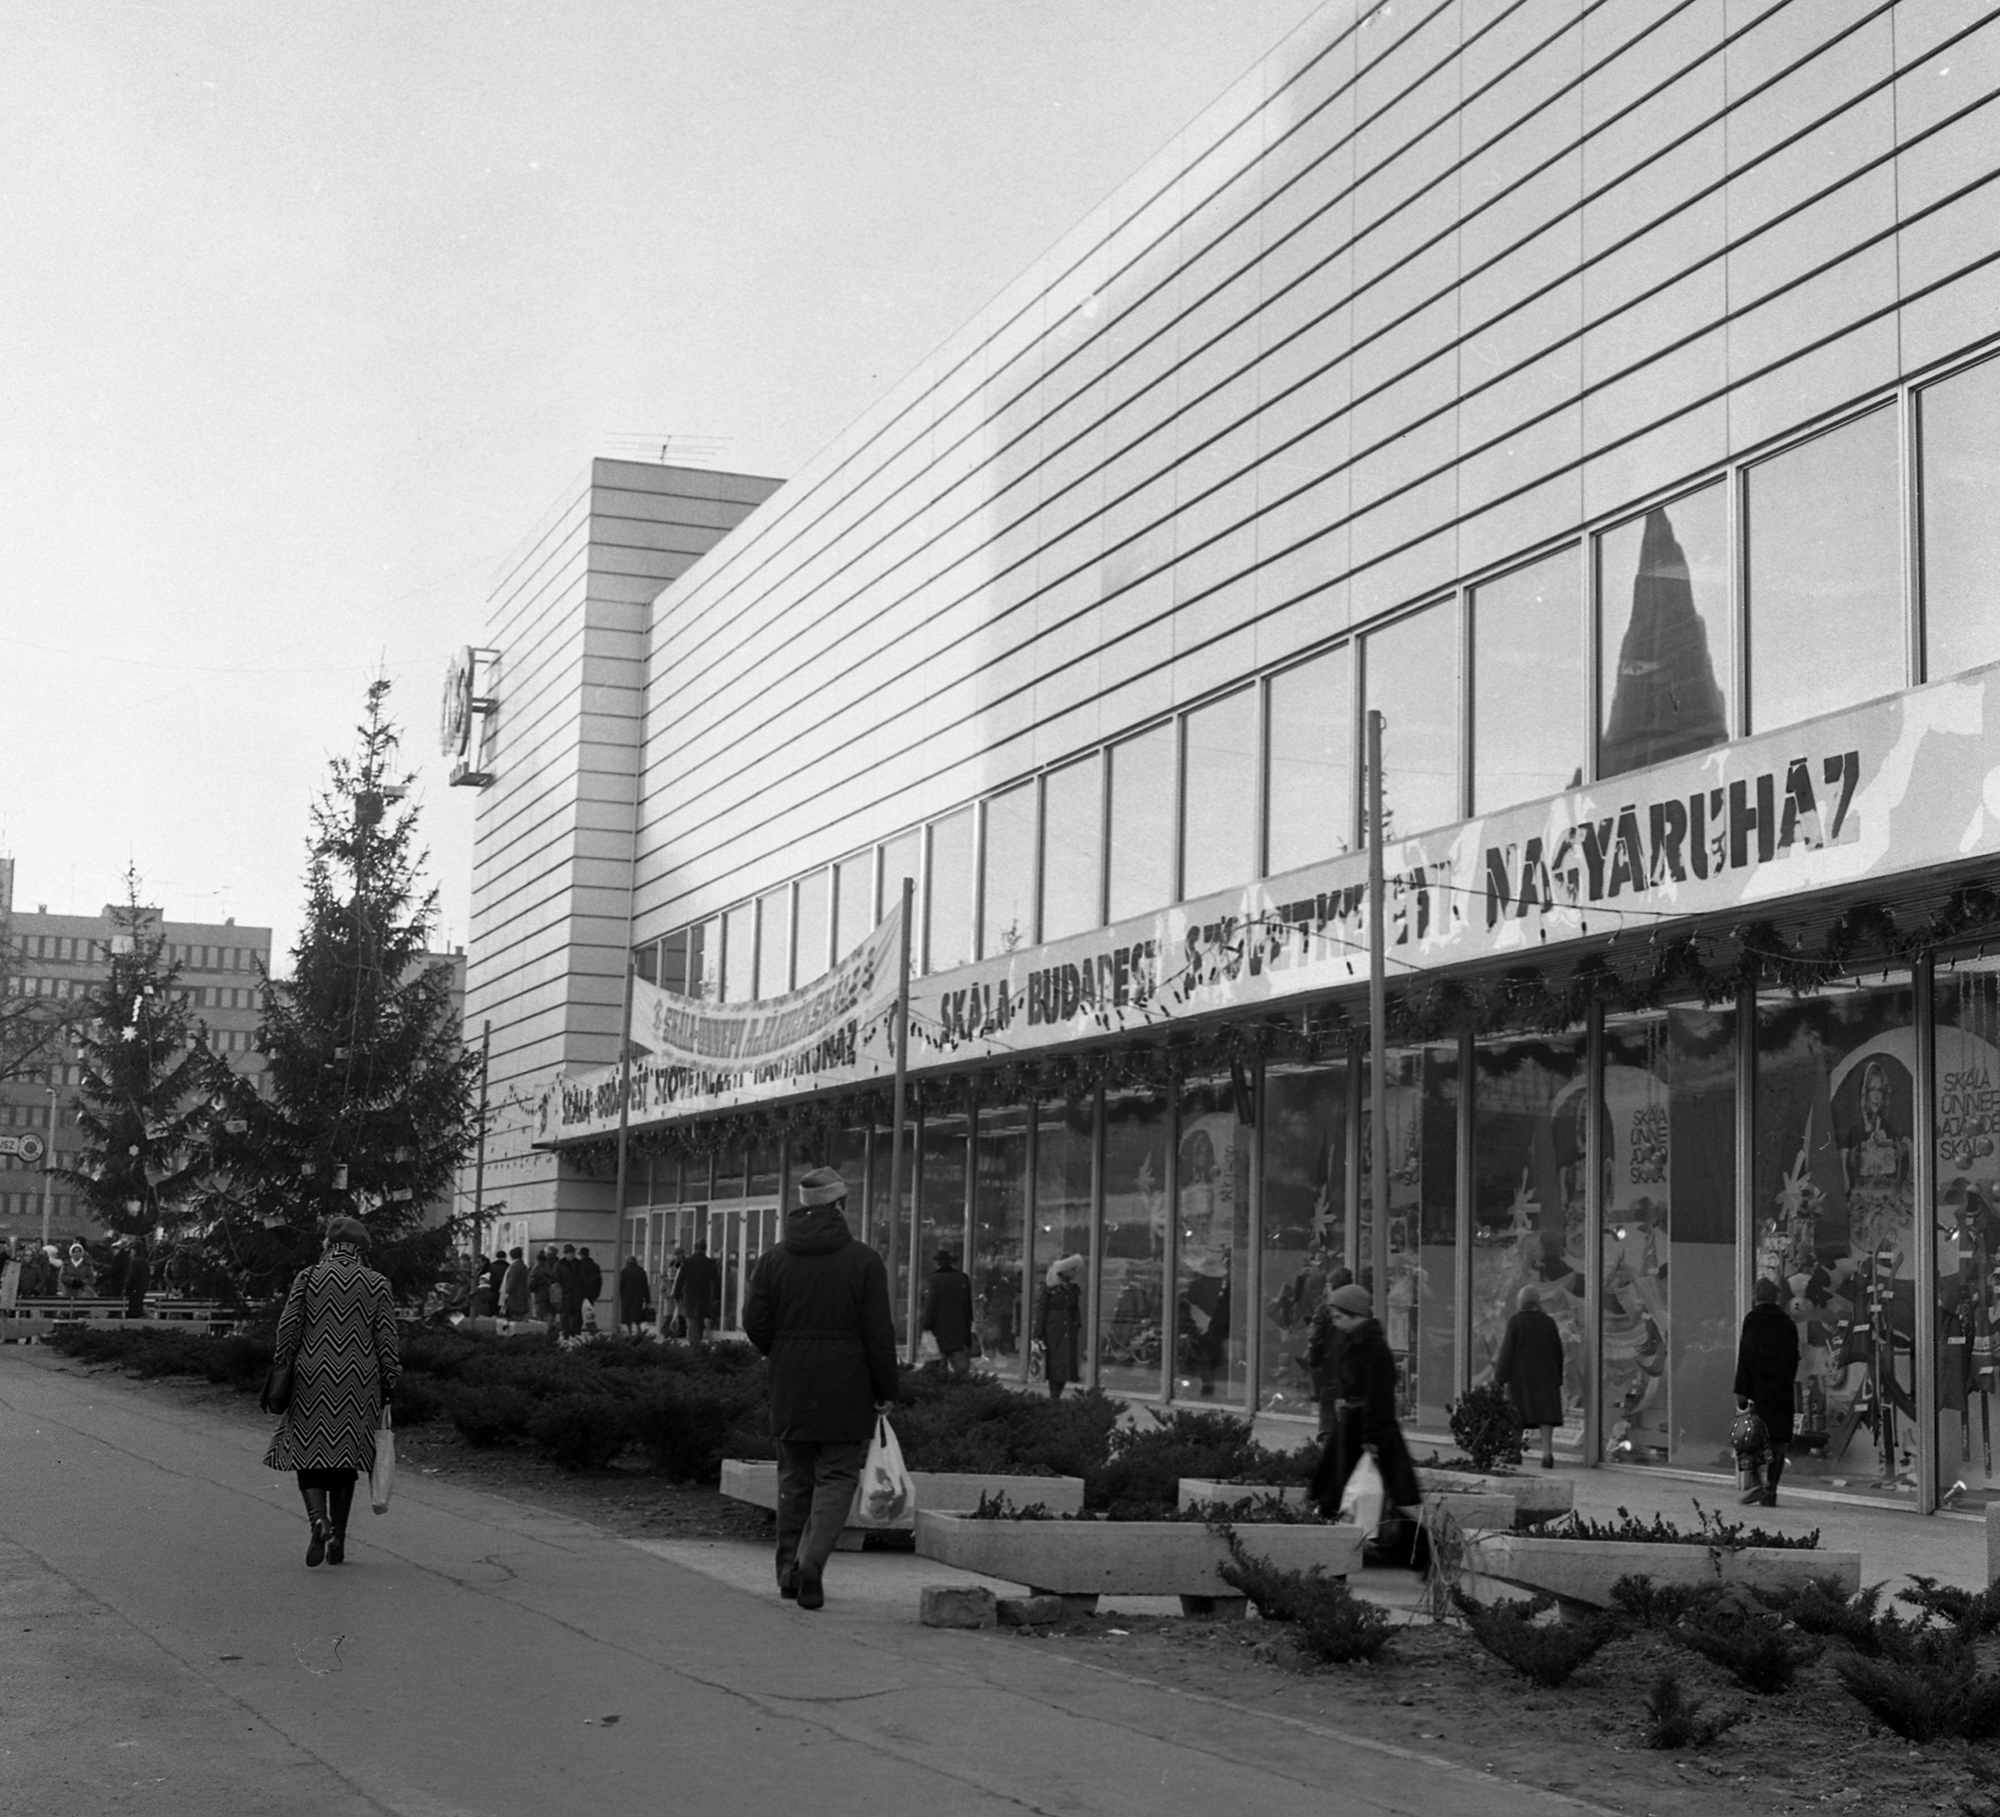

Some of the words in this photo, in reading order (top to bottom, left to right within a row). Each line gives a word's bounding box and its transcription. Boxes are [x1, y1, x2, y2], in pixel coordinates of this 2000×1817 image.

[941, 982, 1010, 1043] SKÁLA
[1027, 939, 1158, 1026] BUDAPEST
[1486, 750, 1860, 925] NAGYÁRUHÁZ
